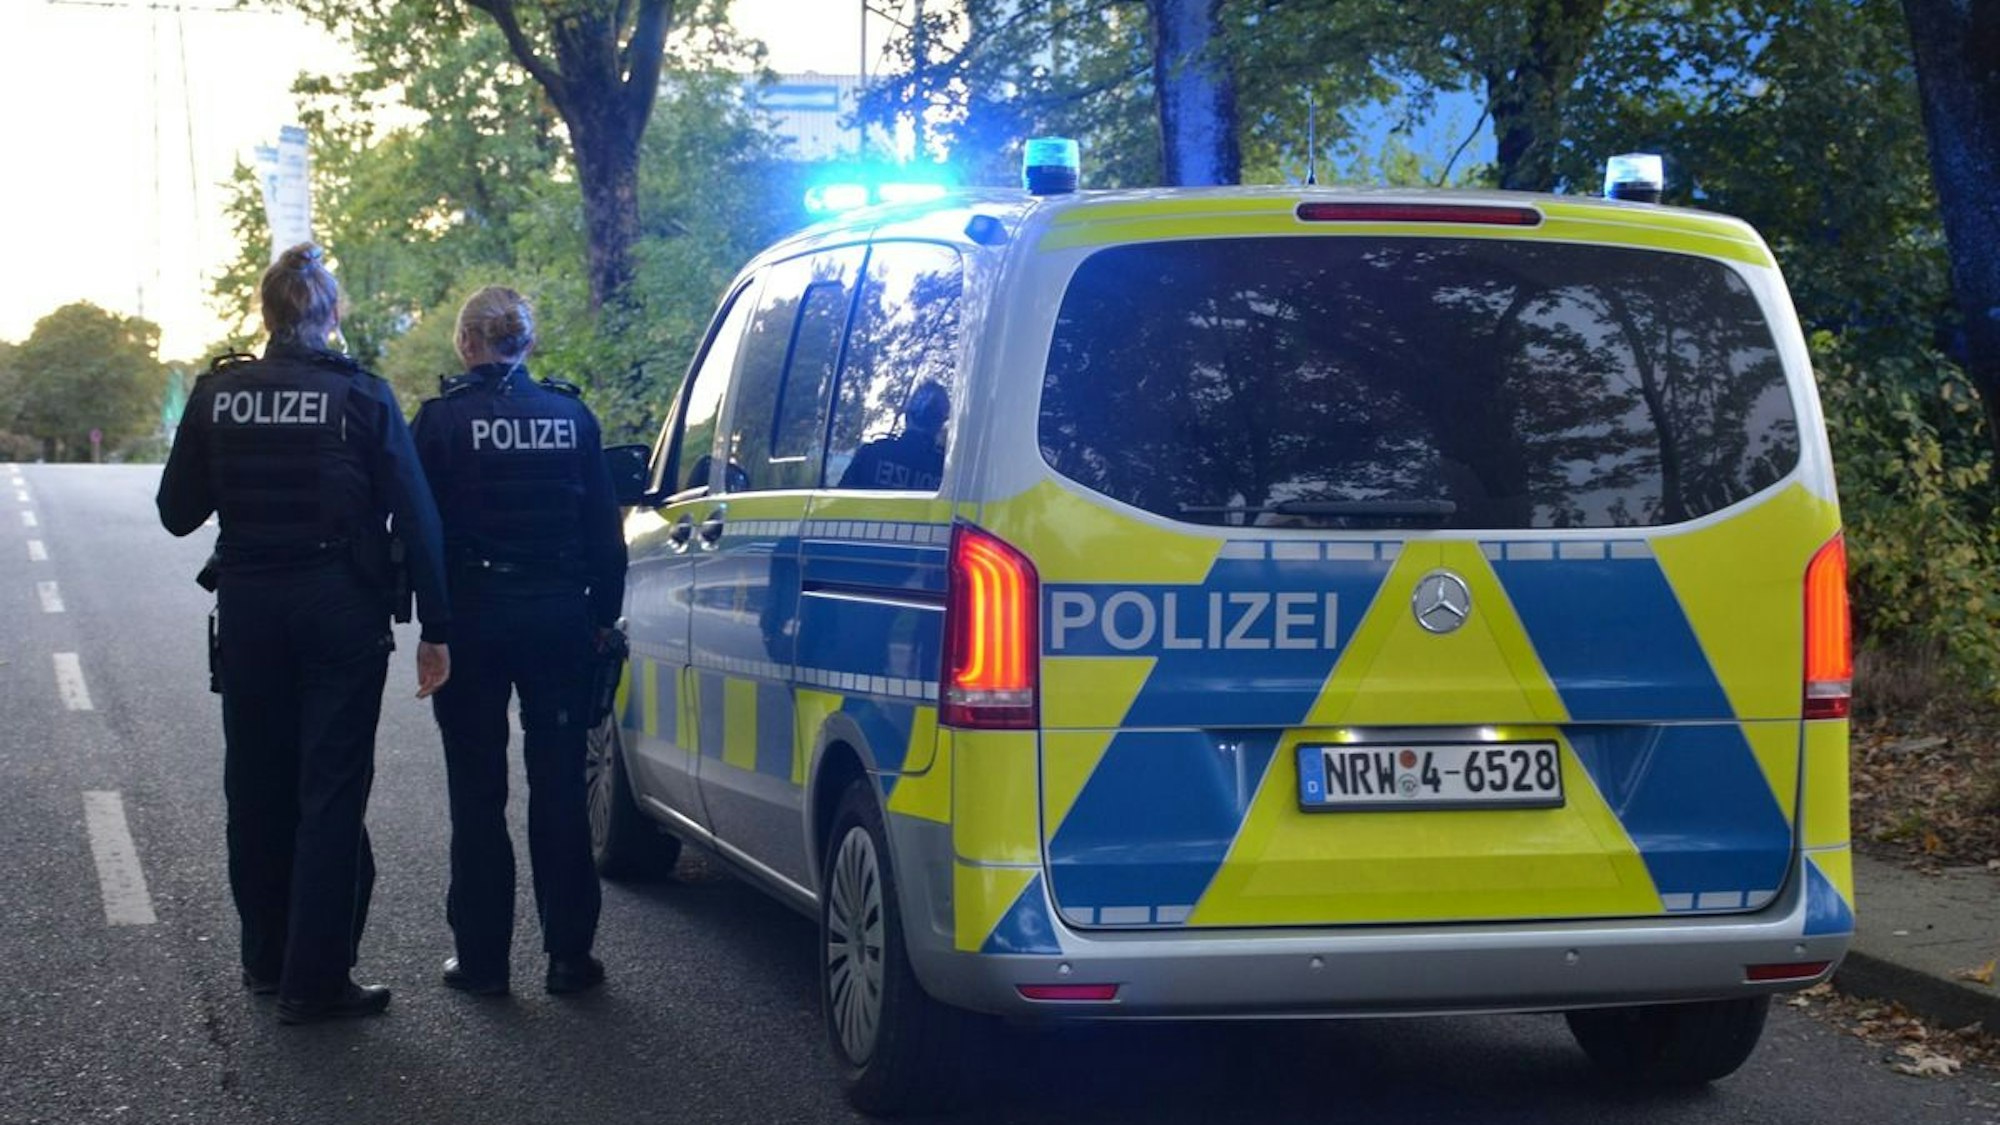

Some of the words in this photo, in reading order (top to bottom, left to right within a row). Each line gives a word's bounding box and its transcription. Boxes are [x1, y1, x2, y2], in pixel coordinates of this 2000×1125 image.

[212, 391, 328, 424] POLIZEI
[472, 418, 576, 449] POLIZEI
[1051, 591, 1338, 649] POLIZEI
[1324, 752, 1395, 795] NRW
[1421, 750, 1556, 793] 4-6528
